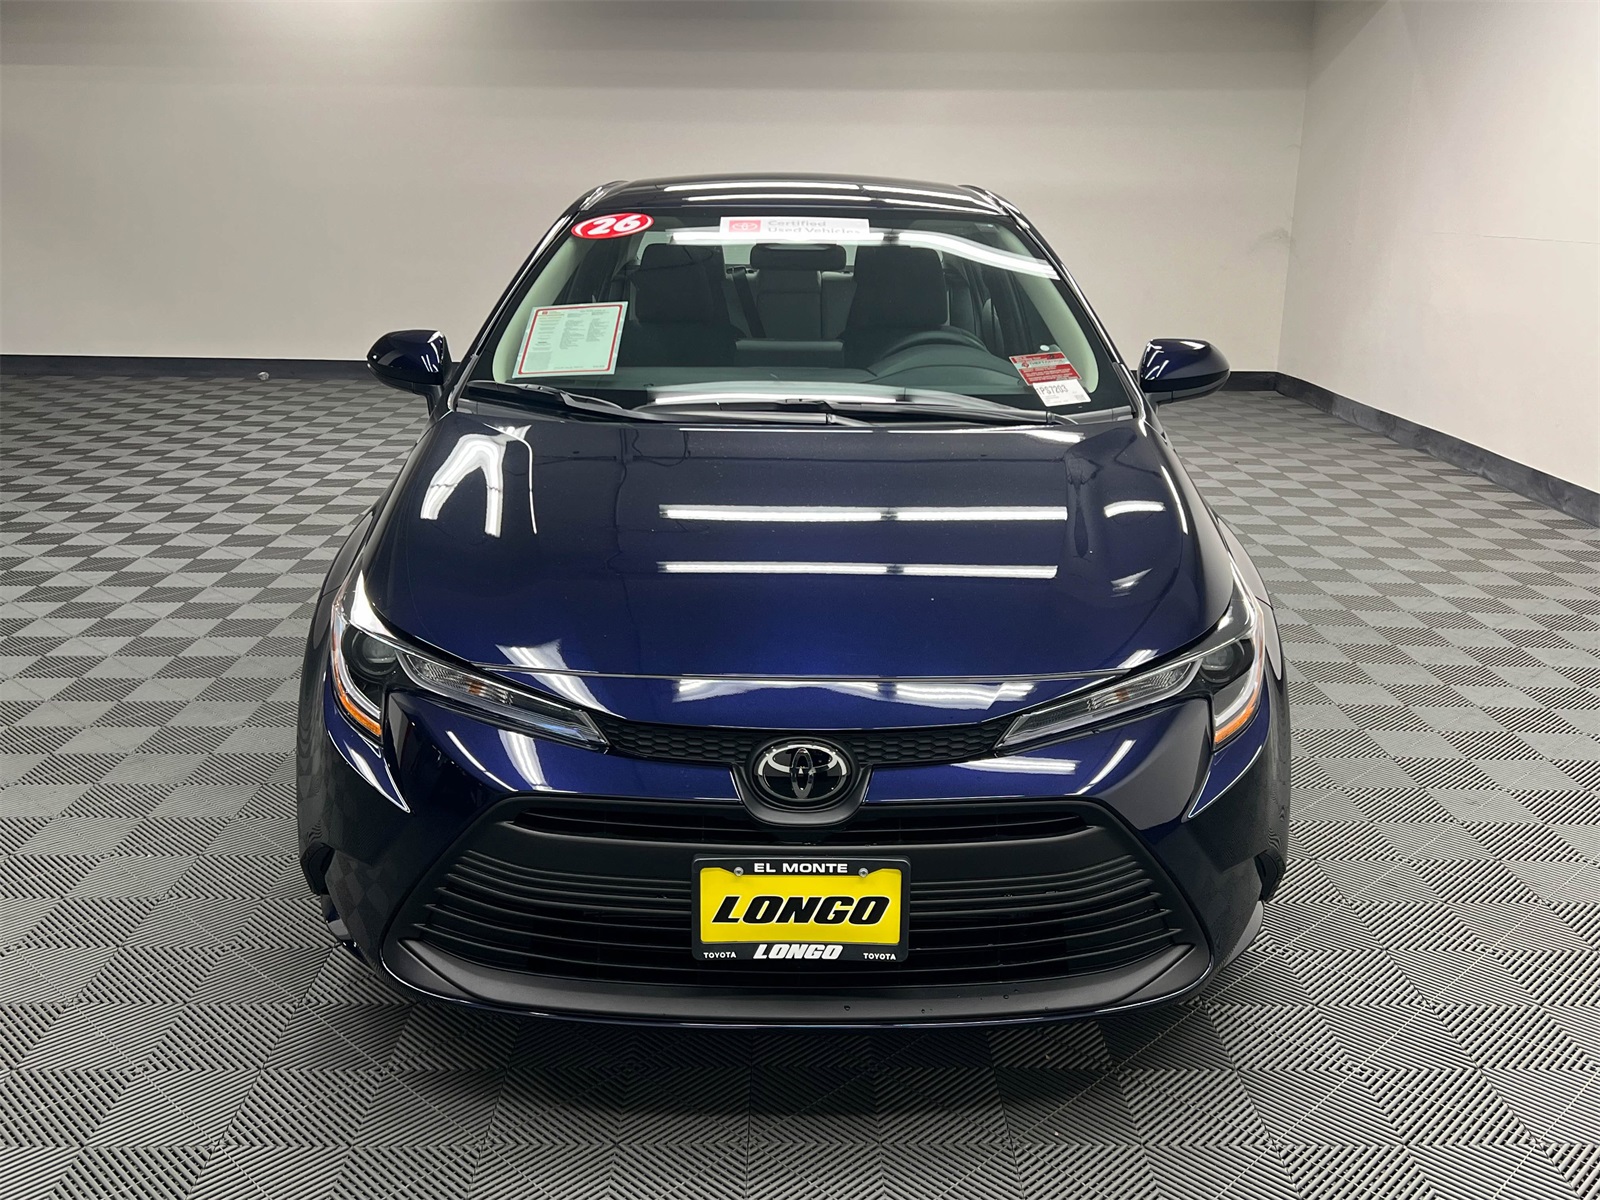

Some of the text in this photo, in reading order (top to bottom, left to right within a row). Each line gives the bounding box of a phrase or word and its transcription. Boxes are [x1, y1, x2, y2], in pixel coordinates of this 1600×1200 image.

[587, 214, 642, 235] 26
[767, 219, 826, 227] Certified
[754, 863, 848, 873] EL MONTE
[711, 895, 890, 925] LONGO
[703, 951, 737, 959] TOYOTA
[752, 944, 843, 960] LONGO
[863, 952, 897, 960] TOYOTA
